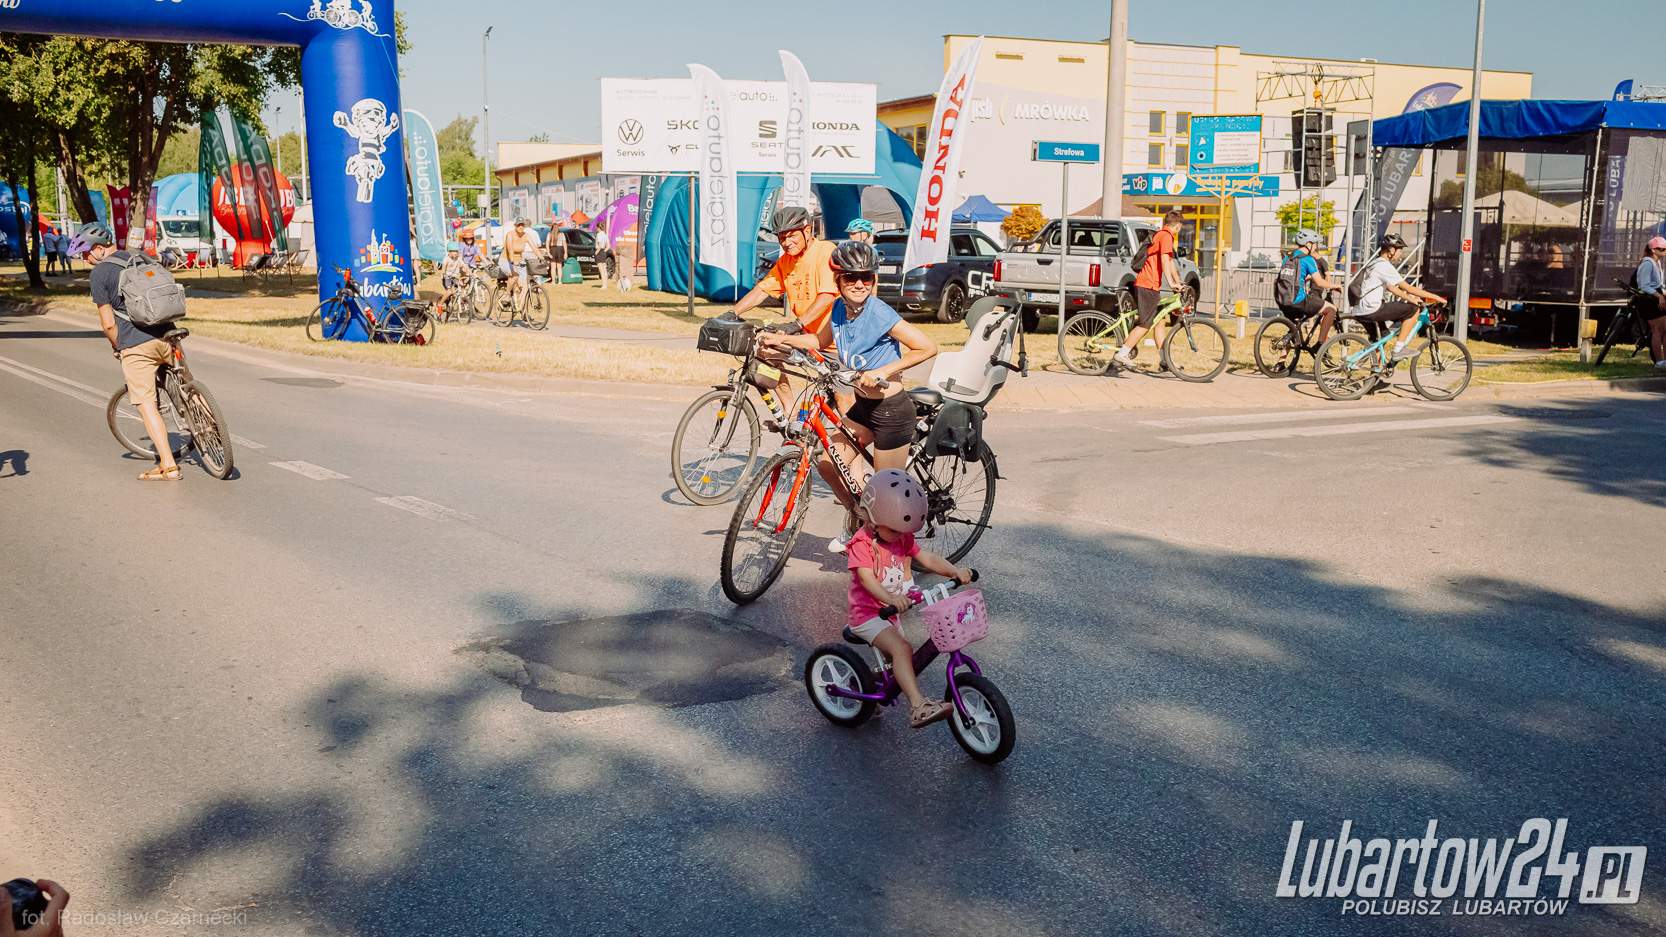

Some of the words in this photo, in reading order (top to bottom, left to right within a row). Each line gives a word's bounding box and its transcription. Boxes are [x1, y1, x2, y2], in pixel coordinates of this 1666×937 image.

[1014, 101, 1089, 121] MRÓWKA
[616, 148, 645, 158] Serwis
[920, 73, 967, 243] HONDA
[1053, 146, 1085, 158] Strefowa
[1381, 149, 1412, 202] LUBAR
